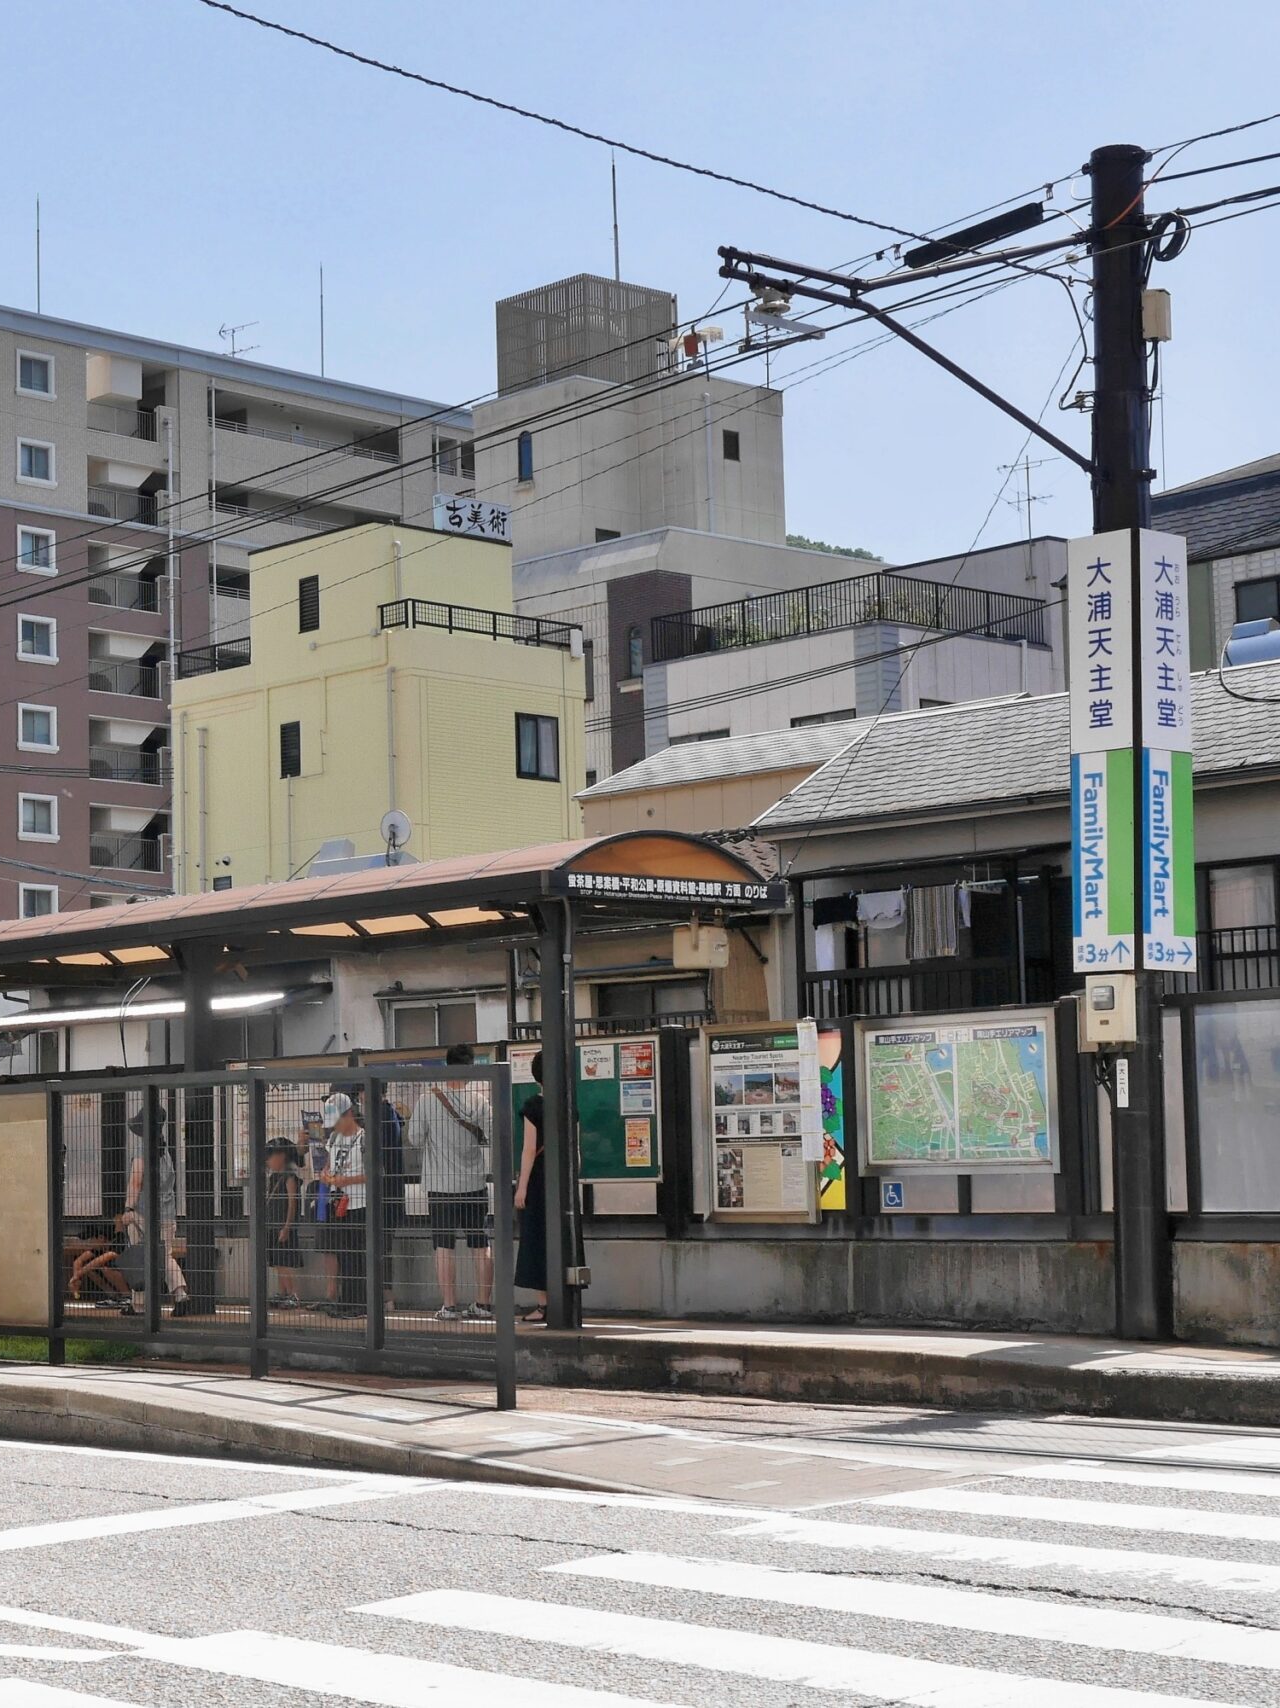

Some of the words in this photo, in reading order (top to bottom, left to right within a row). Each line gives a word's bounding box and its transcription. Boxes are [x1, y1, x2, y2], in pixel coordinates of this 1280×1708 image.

[446, 500, 507, 536] 古美術
[1087, 557, 1113, 729] 大浦天主堂
[1154, 555, 1177, 728] 大浦天主堂
[725, 883, 741, 898] 方面
[744, 885, 768, 899] のりば
[1081, 772, 1104, 918] FamilyMart
[1150, 770, 1169, 917] FamilyMart
